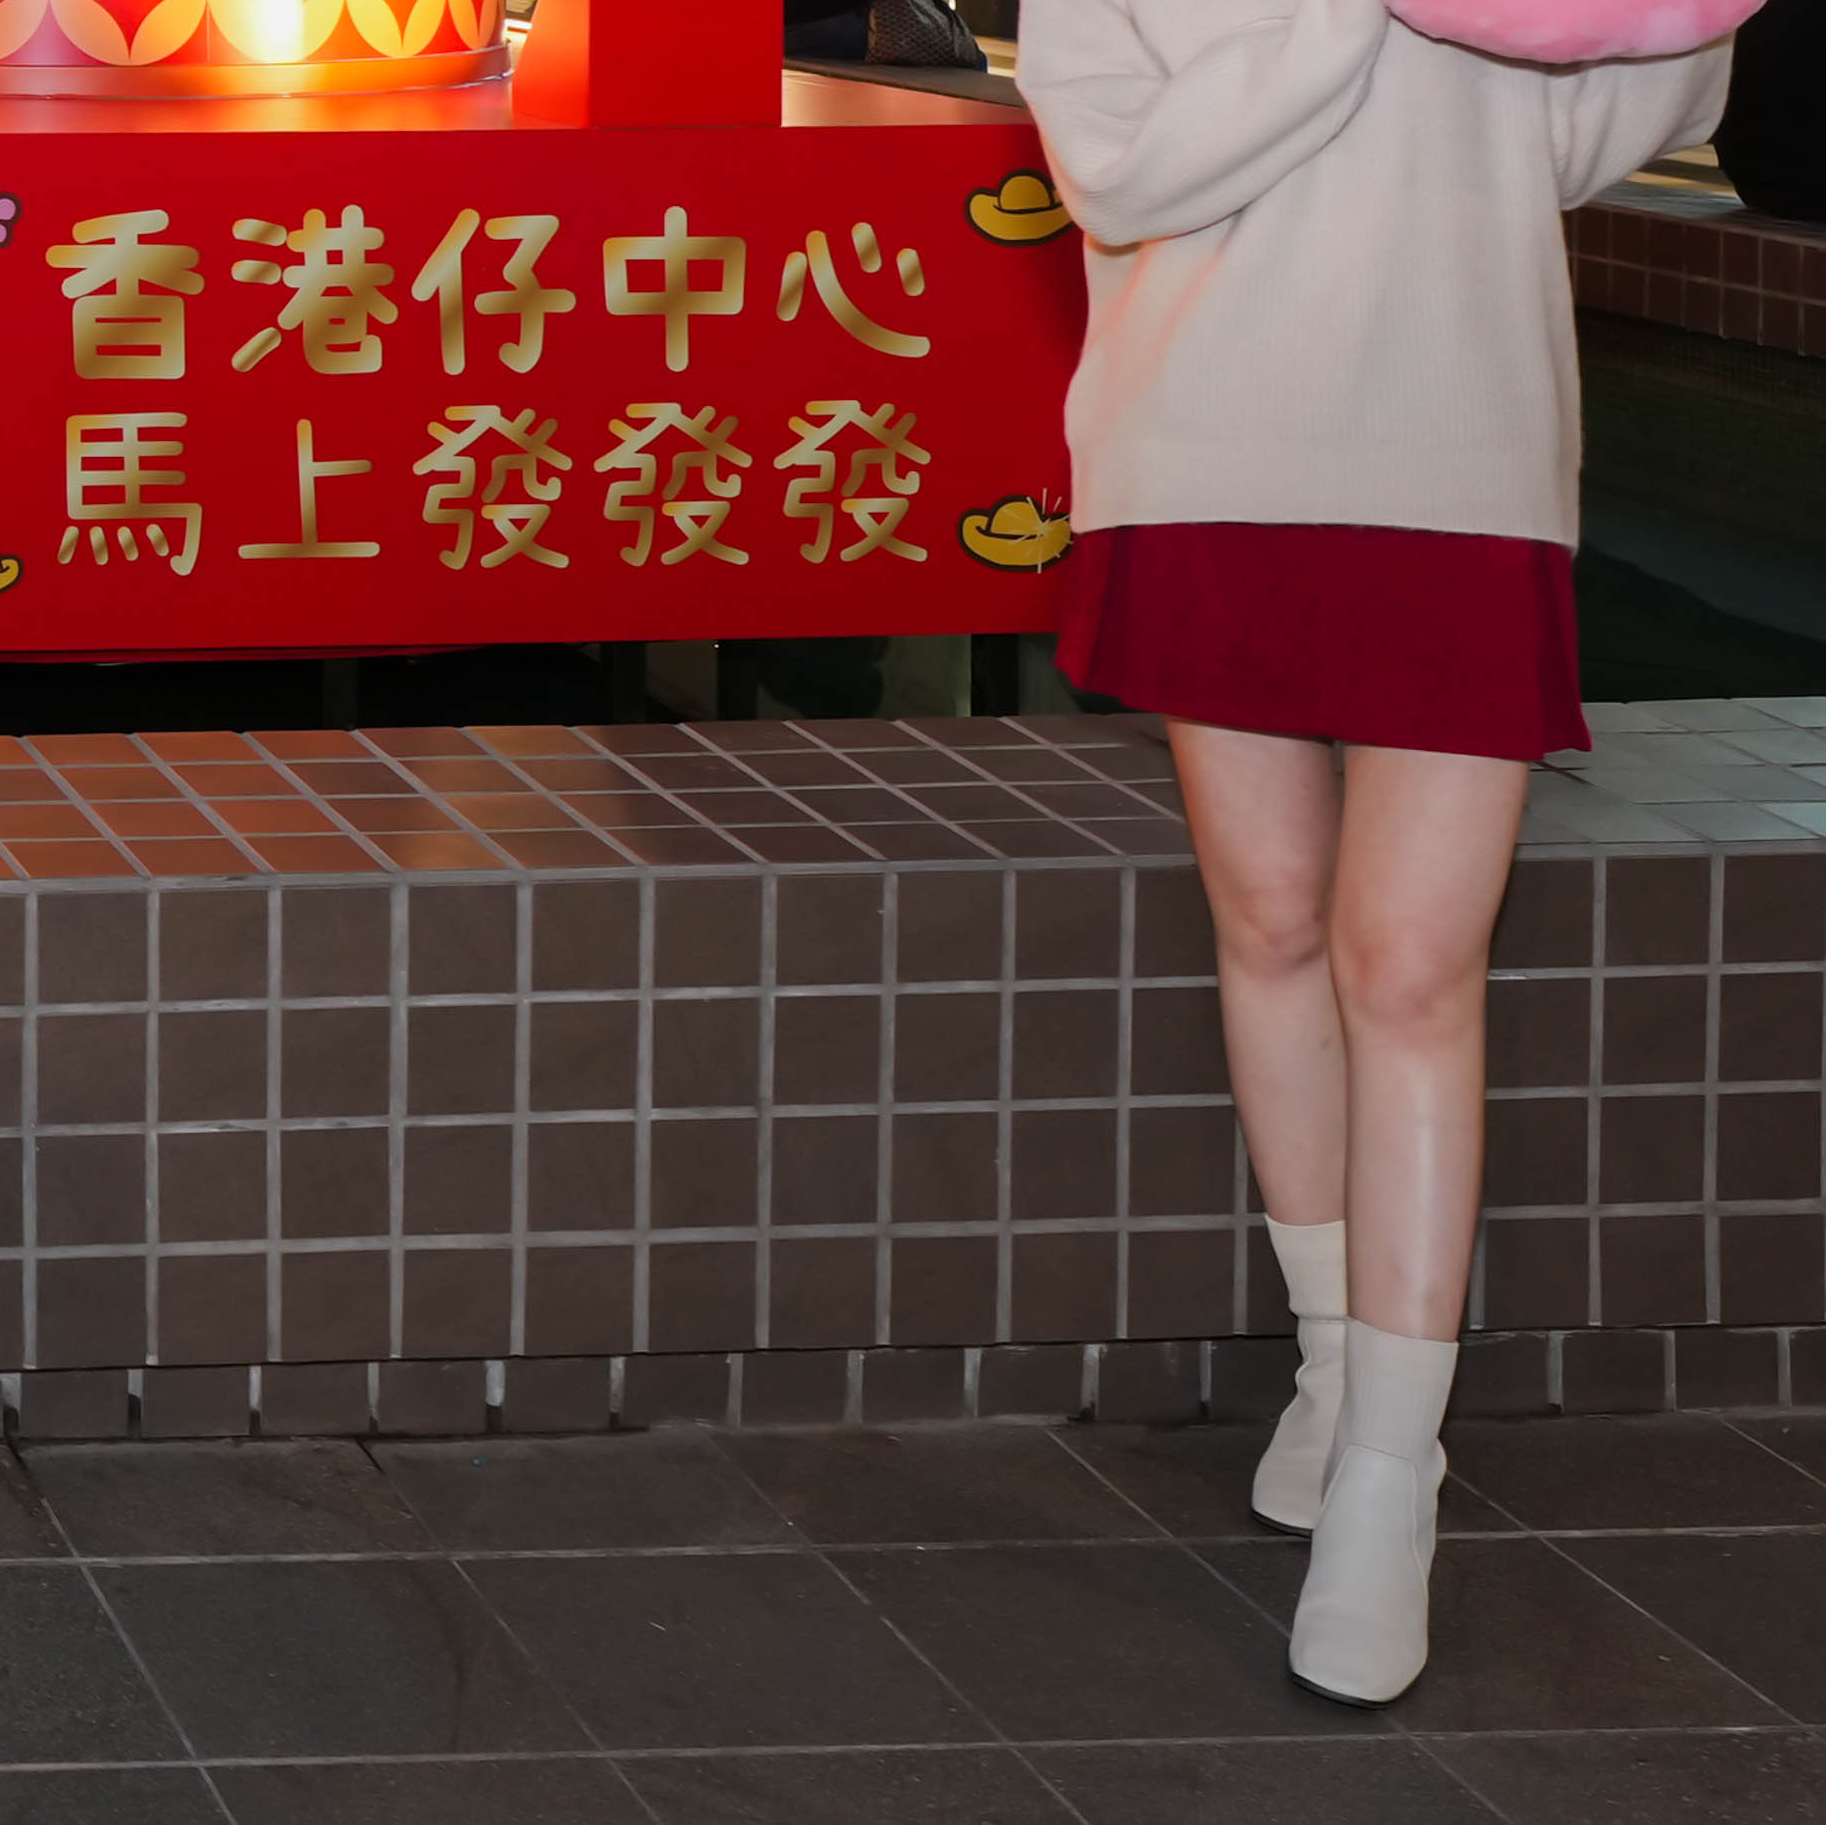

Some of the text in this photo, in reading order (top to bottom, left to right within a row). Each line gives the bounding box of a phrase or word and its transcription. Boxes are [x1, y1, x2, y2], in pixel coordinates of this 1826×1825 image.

[46, 204, 931, 380] 香港仔中心
[57, 399, 932, 576] 馬上發發發
